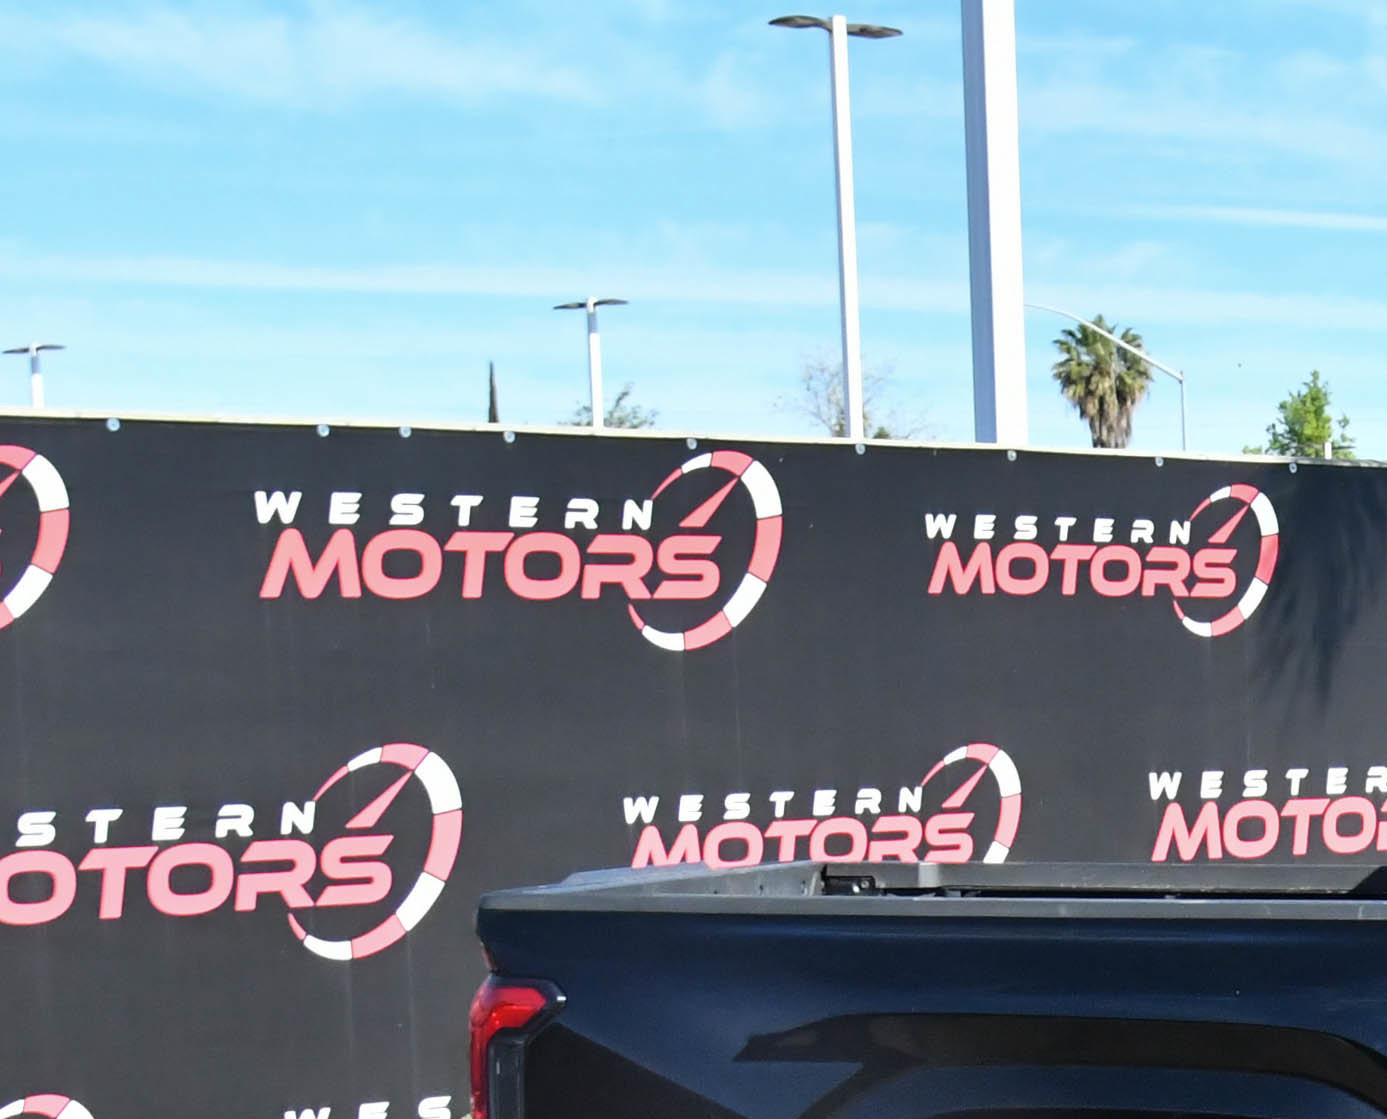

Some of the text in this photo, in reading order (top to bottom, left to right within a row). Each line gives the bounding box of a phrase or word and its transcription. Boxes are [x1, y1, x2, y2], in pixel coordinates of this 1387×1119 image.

[255, 491, 653, 530] WESTERN
[925, 513, 1191, 544] WESTERN
[259, 528, 722, 600] MOTORS
[928, 541, 1237, 598] MOTORS
[15, 801, 316, 847] STERN
[623, 786, 923, 824] WESTERN
[631, 812, 975, 870] MOTORS
[0, 834, 394, 925] OTORS
